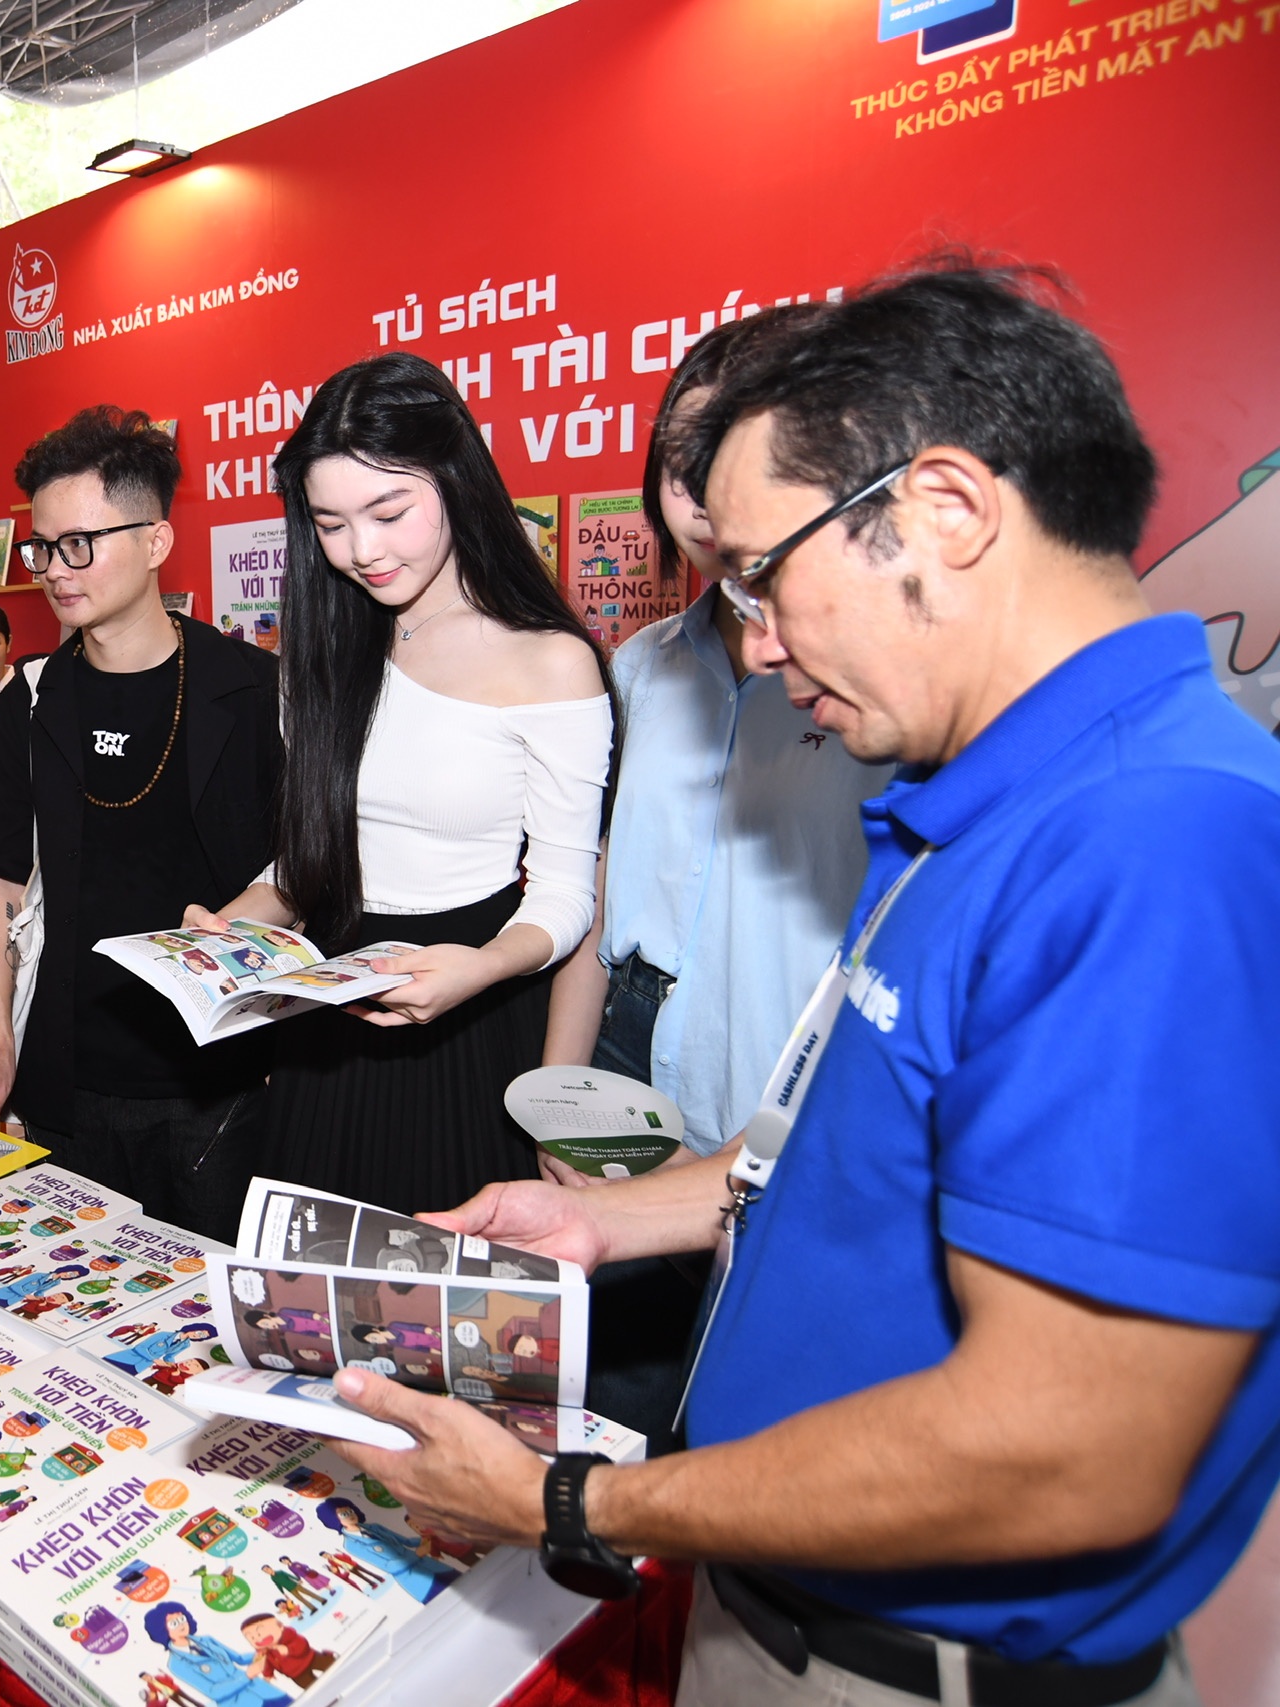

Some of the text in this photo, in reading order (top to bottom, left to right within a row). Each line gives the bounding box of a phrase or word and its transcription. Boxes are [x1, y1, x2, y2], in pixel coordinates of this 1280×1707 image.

[850, 80, 928, 119] THÚC
[935, 55, 1001, 95] ĐẨY
[1008, 26, 1098, 74] PHÁT
[895, 89, 1004, 139] KHÔNG
[1012, 65, 1091, 104] TIỀN
[1096, 36, 1181, 82] MẶT
[1185, 16, 1245, 56] AN
[73, 268, 299, 347] NHÀ XUẤT BẢN KIM ĐỒNG
[372, 274, 556, 347] TỦ SÁCH
[6, 329, 29, 364] KIM
[203, 379, 324, 442] THÔN
[512, 323, 607, 392] TÀI
[520, 394, 635, 463] VỚI
[578, 519, 620, 544] ĐẦU
[622, 541, 650, 561] TƯ
[229, 547, 268, 573] KHÉO
[231, 601, 253, 612] TRÁNH
[241, 574, 264, 599] VỚI
[578, 578, 653, 600] THÔNG
[622, 602, 680, 620] MINH
[92, 730, 131, 745] TRY
[778, 1031, 819, 1107] CASHLESS DAY
[24, 1183, 82, 1212] VỚI TIỀN
[31, 1173, 109, 1208] KHÉO KHÔN
[111, 1236, 178, 1264] VỚI TIỀN
[116, 1223, 205, 1259] KHÉO KHÔN
[8, 1387, 36, 1405] TRÁNH
[34, 1402, 65, 1422] NHỮNG
[75, 1429, 106, 1450] PHIỀN
[33, 1384, 114, 1434] VỚI TIỀN
[42, 1366, 151, 1429] KHÉO KHÔN
[186, 1438, 250, 1476] KHÉO
[225, 1428, 316, 1481] VỚI TIỀN
[234, 1477, 269, 1500] TRÁNH
[266, 1456, 301, 1480] NHỮNG
[11, 1522, 85, 1575] KHÉO
[80, 1476, 148, 1527] KHÔN
[52, 1504, 160, 1579] VỚI TIỀN
[56, 1576, 99, 1606] TRÁNH
[99, 1547, 138, 1579] NHỮNG
[153, 1508, 189, 1536] PHIỀN
